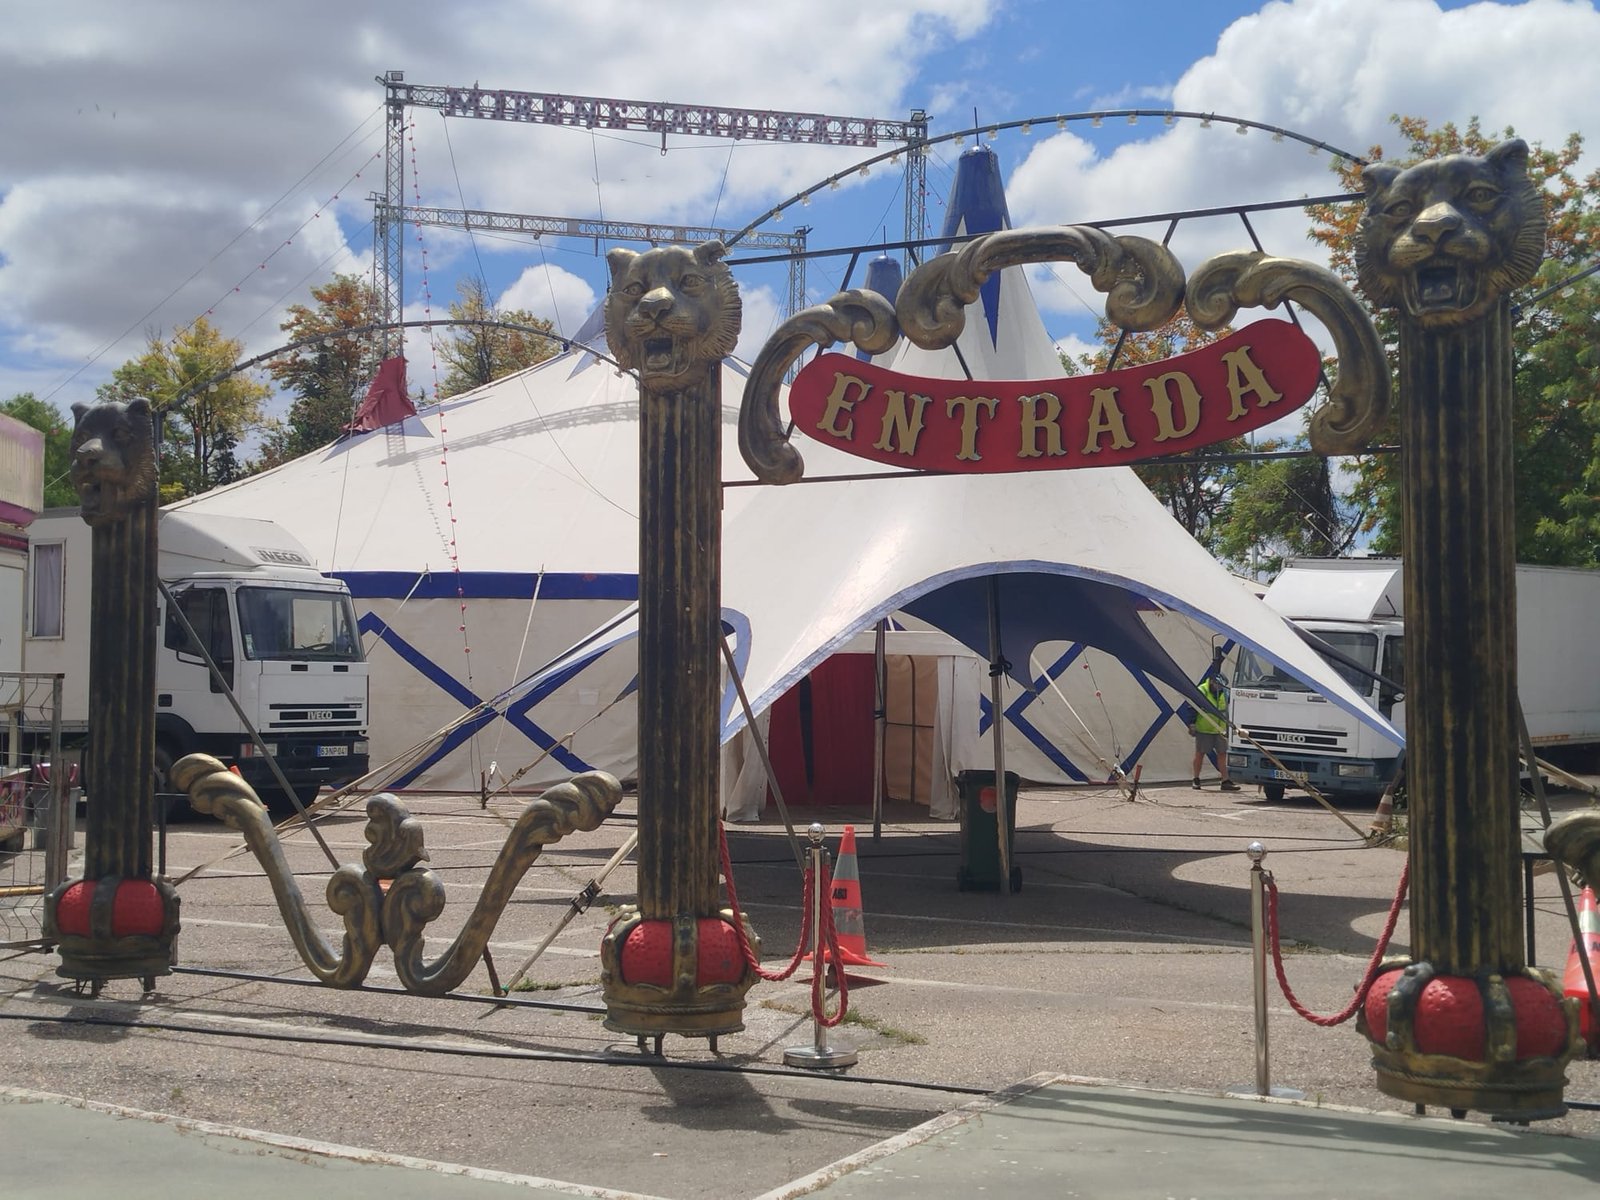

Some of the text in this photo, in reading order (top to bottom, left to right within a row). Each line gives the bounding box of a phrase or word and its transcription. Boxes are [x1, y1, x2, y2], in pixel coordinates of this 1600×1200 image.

[816, 345, 1283, 461] ENTRADA
[257, 550, 303, 562] IVECO
[307, 711, 333, 720] IVECO
[1276, 733, 1306, 743] IVECO
